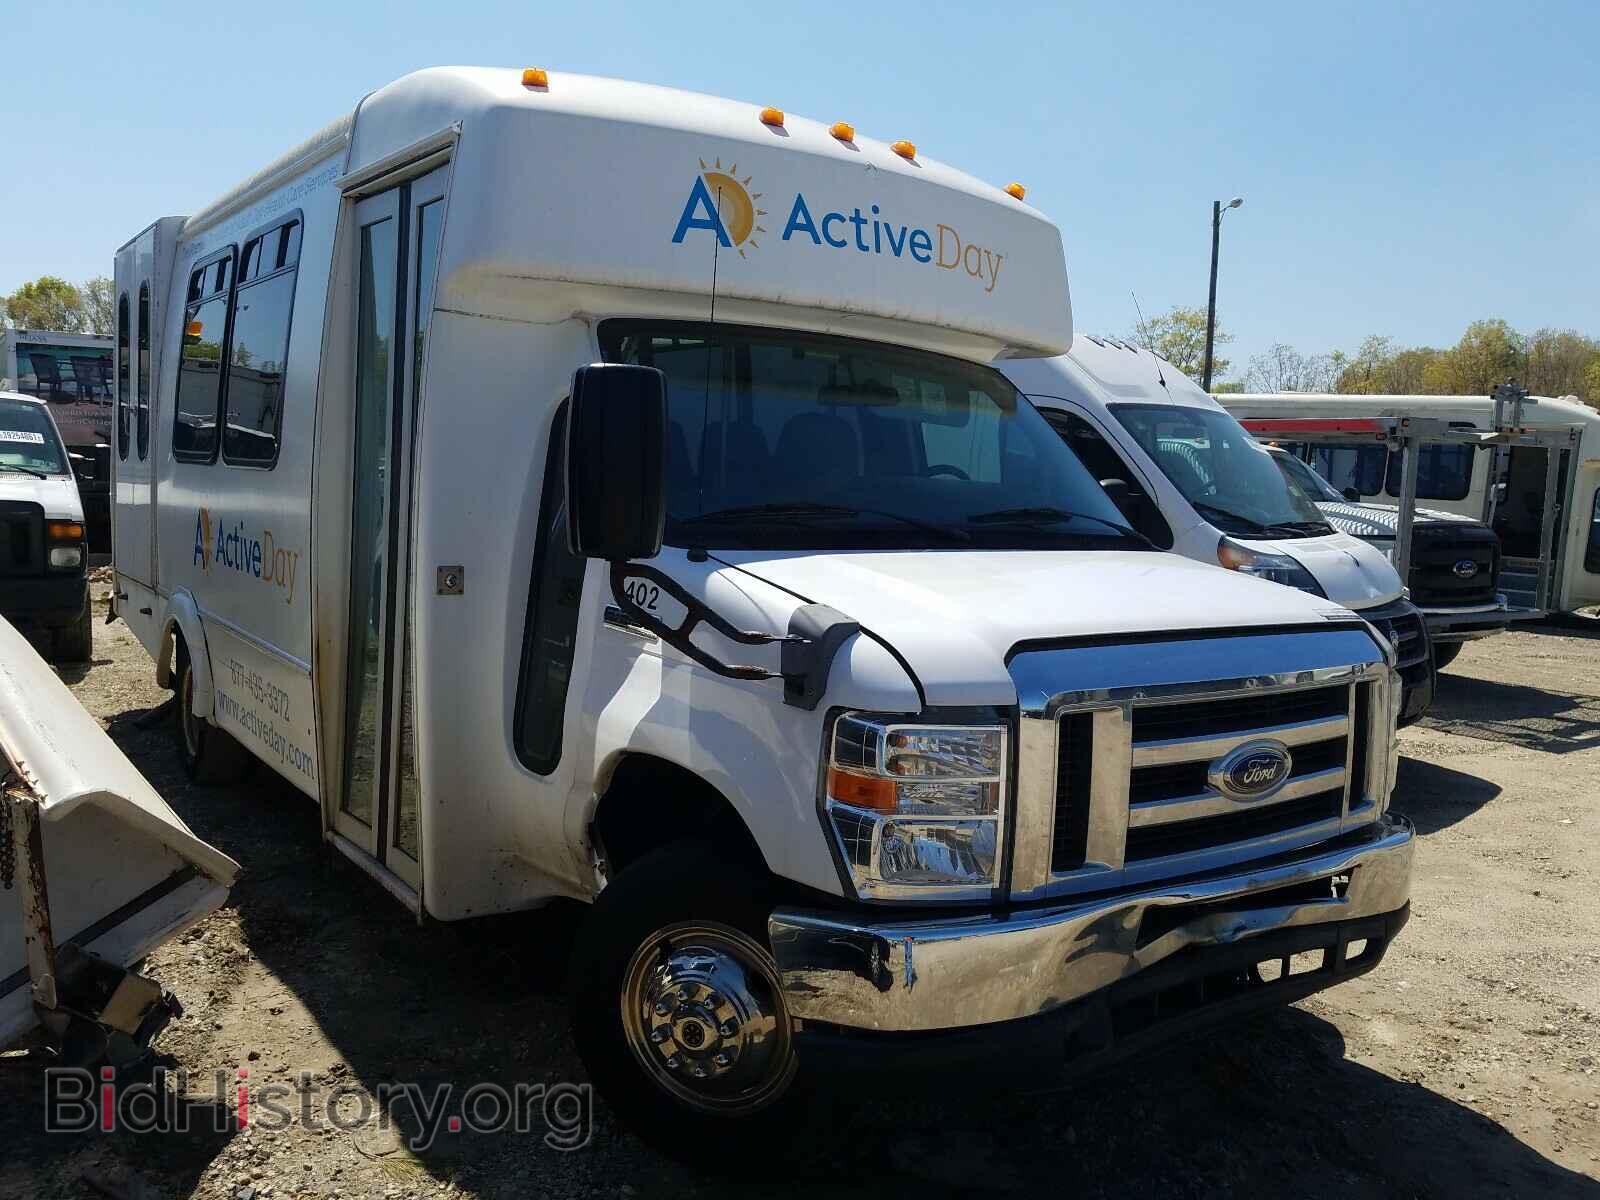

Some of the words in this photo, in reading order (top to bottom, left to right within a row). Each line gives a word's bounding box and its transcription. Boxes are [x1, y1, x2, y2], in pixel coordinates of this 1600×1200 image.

[782, 193, 1003, 292] ActiveDay
[216, 519, 298, 605] ActiveDay
[624, 580, 660, 610] 402
[217, 689, 316, 780] www.activeday.com
[1243, 758, 1278, 784] Ford
